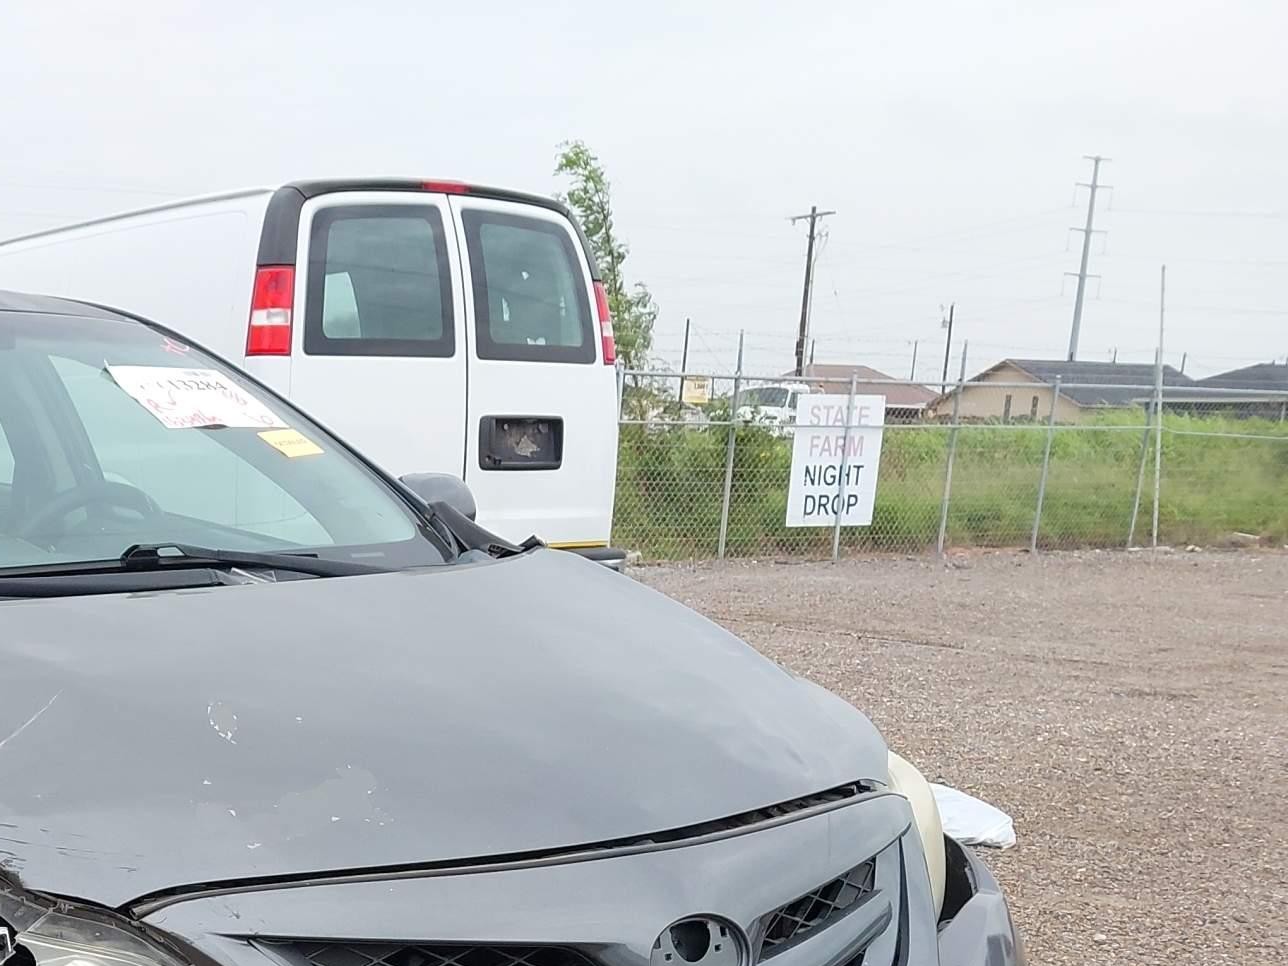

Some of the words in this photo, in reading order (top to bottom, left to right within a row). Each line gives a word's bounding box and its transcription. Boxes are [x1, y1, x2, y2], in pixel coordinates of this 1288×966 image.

[809, 405, 871, 428] STAE
[809, 435, 865, 457] FARM
[803, 464, 865, 487] NIGHT
[803, 494, 859, 517] DROP
